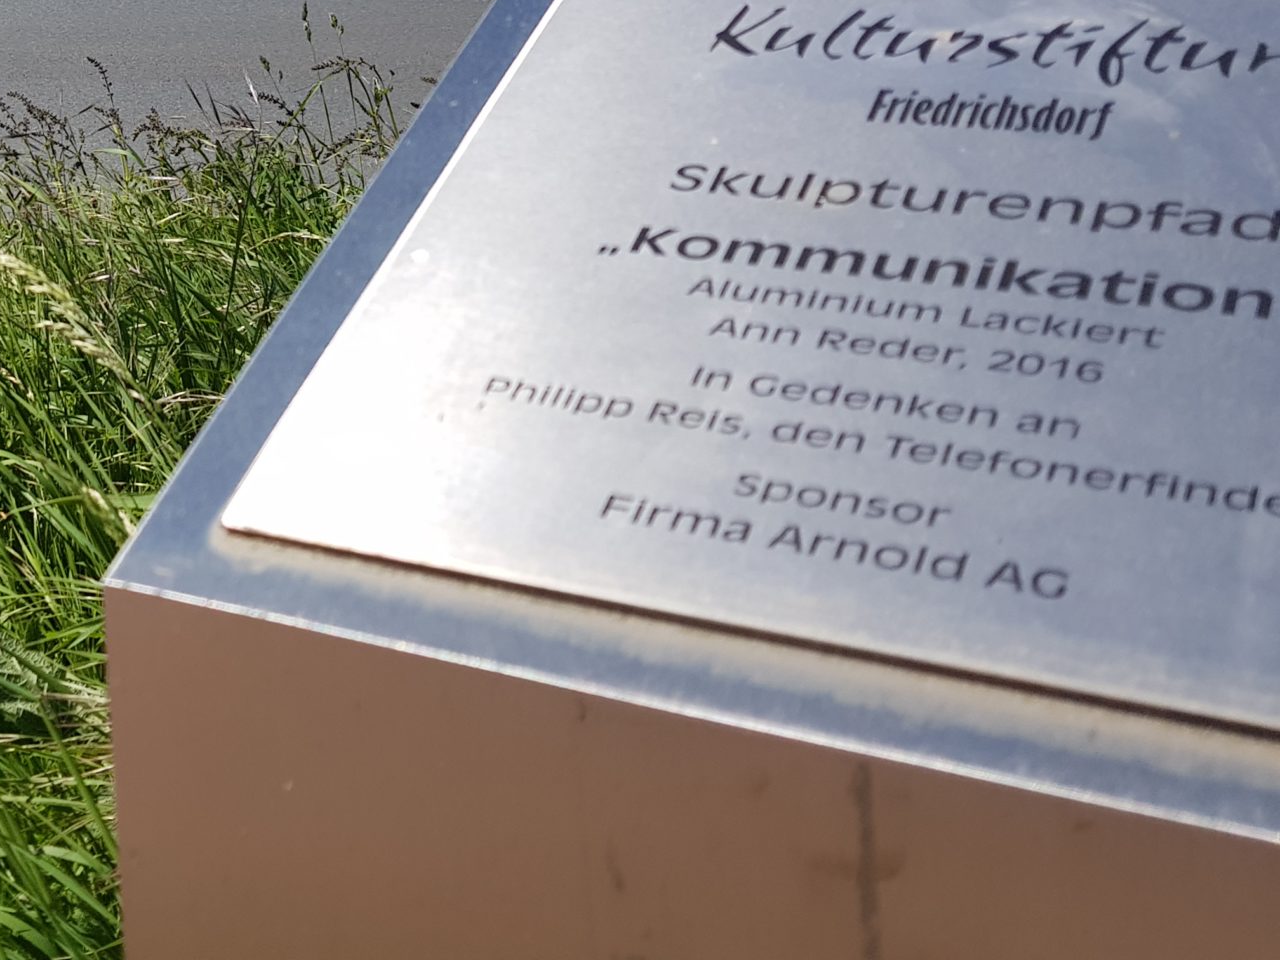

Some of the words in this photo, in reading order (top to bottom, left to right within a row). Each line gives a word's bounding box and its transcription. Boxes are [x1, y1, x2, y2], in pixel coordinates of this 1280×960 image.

[866, 88, 1116, 141] Friedrichsdorf
[669, 163, 1280, 242] Skulpturenpfad
[686, 278, 943, 324] Aluminium
[959, 305, 1166, 349] Lackiert
[708, 317, 801, 346] Ann
[816, 328, 968, 371] Reder,
[986, 349, 1104, 384] 2016
[482, 374, 634, 421] Philipp
[647, 398, 751, 441] Reis,
[771, 419, 867, 455] den
[689, 365, 733, 392] In
[749, 373, 1000, 429] Gedenken
[1014, 412, 1083, 440] an
[599, 493, 754, 544] Firma
[768, 523, 970, 584] Arnold
[983, 559, 1070, 601] AG
